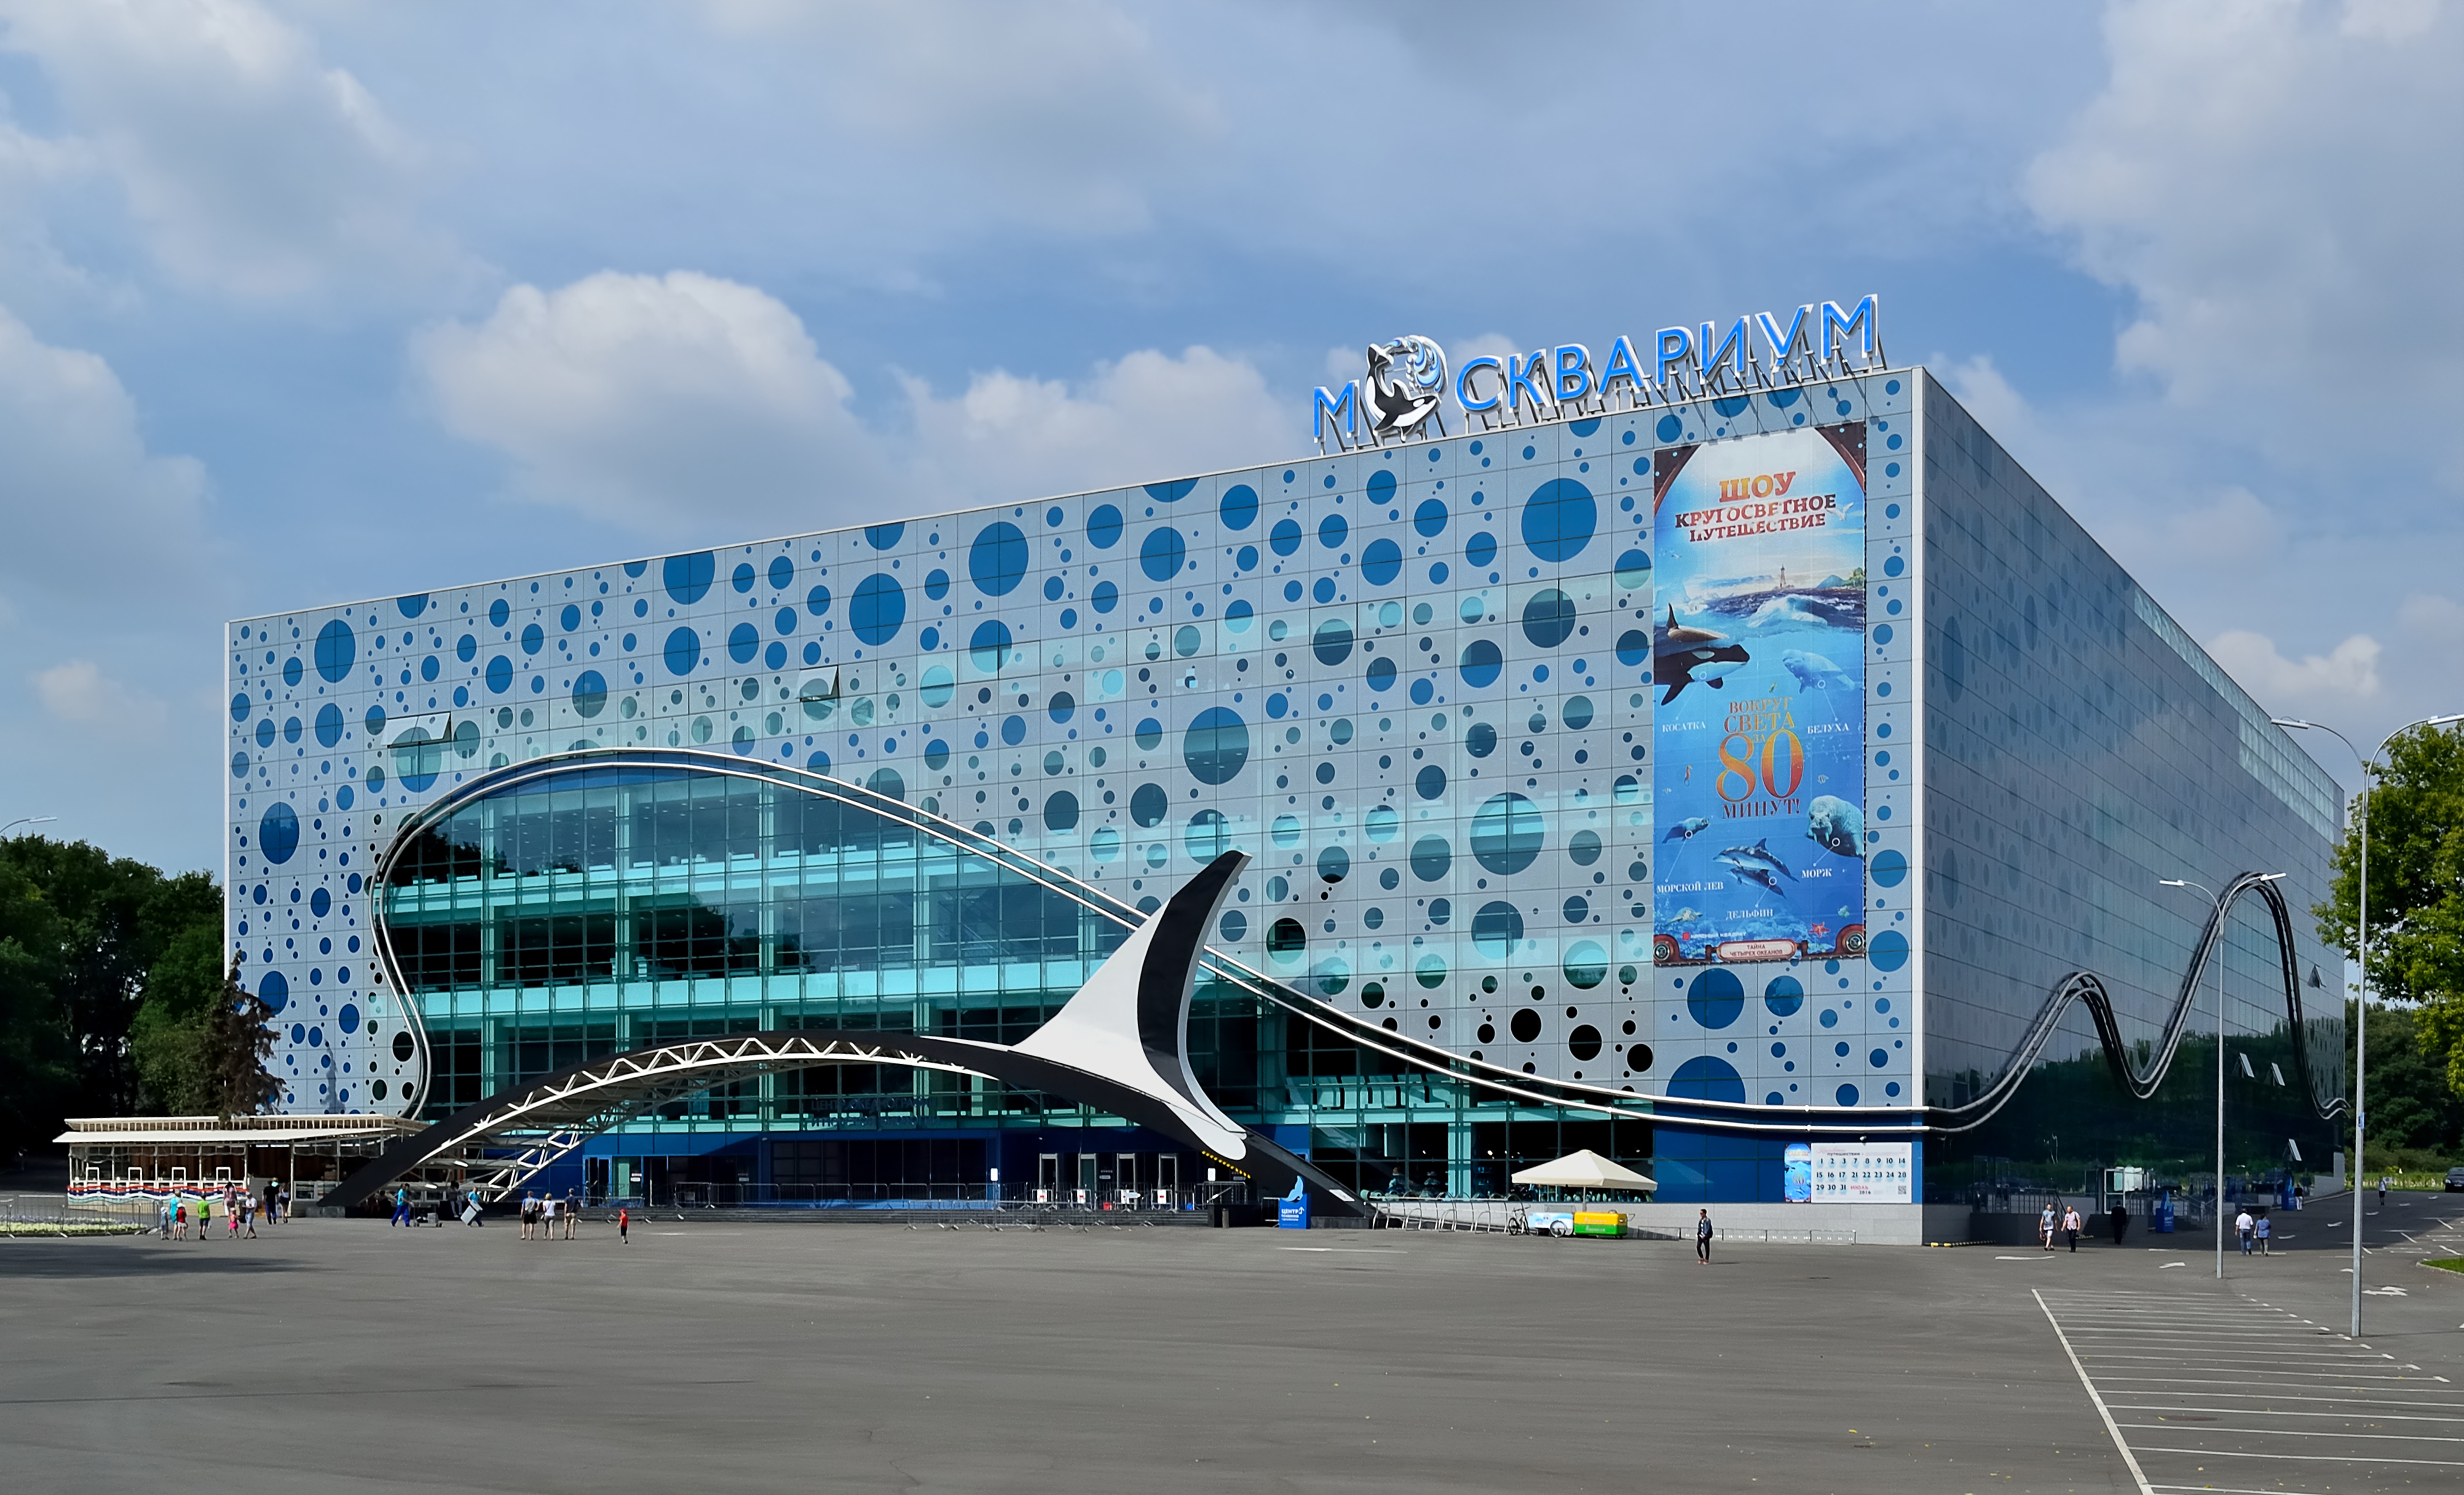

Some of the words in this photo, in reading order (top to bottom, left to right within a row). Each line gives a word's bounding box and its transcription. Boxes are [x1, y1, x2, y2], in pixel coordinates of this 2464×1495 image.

[1720, 471, 1796, 502] ШОУ
[1675, 494, 1836, 528] КРУГОСВЕТНОЕ
[1689, 514, 1826, 542] ПУТЕШЕСТВИЕ
[1729, 697, 1793, 714] ВОКРУГ
[1662, 721, 1706, 732] КОСАТКА
[1724, 712, 1795, 734] СВЕТА
[1807, 722, 1850, 734] БЕЛУХА
[1753, 733, 1766, 743] ЗА
[1716, 728, 1804, 803] 80
[1723, 798, 1801, 819] МИНУТ!
[1801, 868, 1832, 878] МОРЖ
[1657, 881, 1701, 894] МОРСКОЙ
[1705, 881, 1724, 891] ЛЕВ
[1726, 908, 1773, 921] ДЕЛЬФИН
